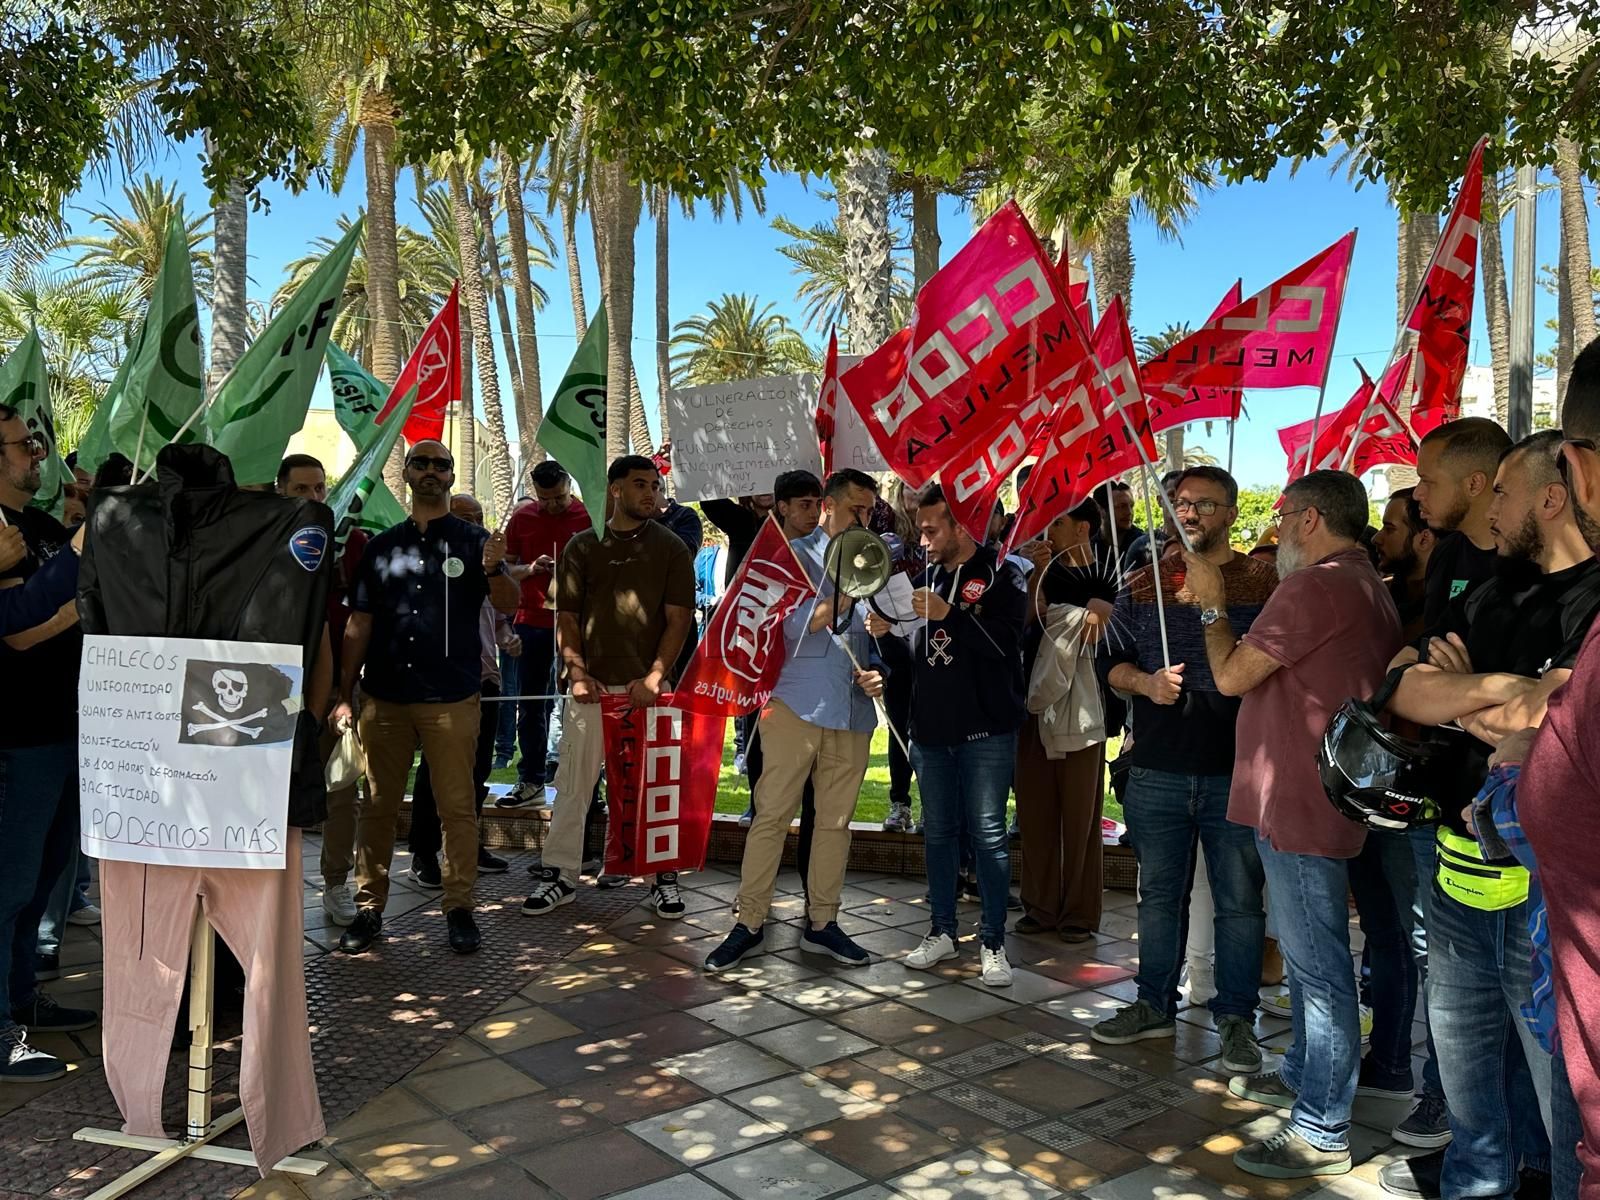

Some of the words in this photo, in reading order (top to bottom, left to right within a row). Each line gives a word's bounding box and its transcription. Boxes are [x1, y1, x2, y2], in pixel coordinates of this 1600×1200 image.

[676, 388, 800, 409] VULNERACIÓN
[715, 406, 735, 418] DE
[704, 417, 774, 434] DERECHOS
[676, 439, 792, 456] FUNDAMENTALES
[677, 455, 799, 474] INCUMPLIMIENTOS
[728, 471, 752, 482] MUY
[701, 482, 757, 498] GRAVES
[86, 645, 179, 671] CHALECOS
[86, 679, 173, 694] UNIFORMIDAD
[81, 704, 124, 718] GUANTES
[93, 757, 115, 770] 100
[118, 759, 145, 775] HORAS
[149, 766, 161, 777] DE
[162, 767, 218, 782] FORMACIÓN
[646, 706, 683, 864] CCOO
[92, 807, 210, 849] PODEMOS
[224, 817, 279, 854] MÁS
[1443, 876, 1485, 897] Champion
